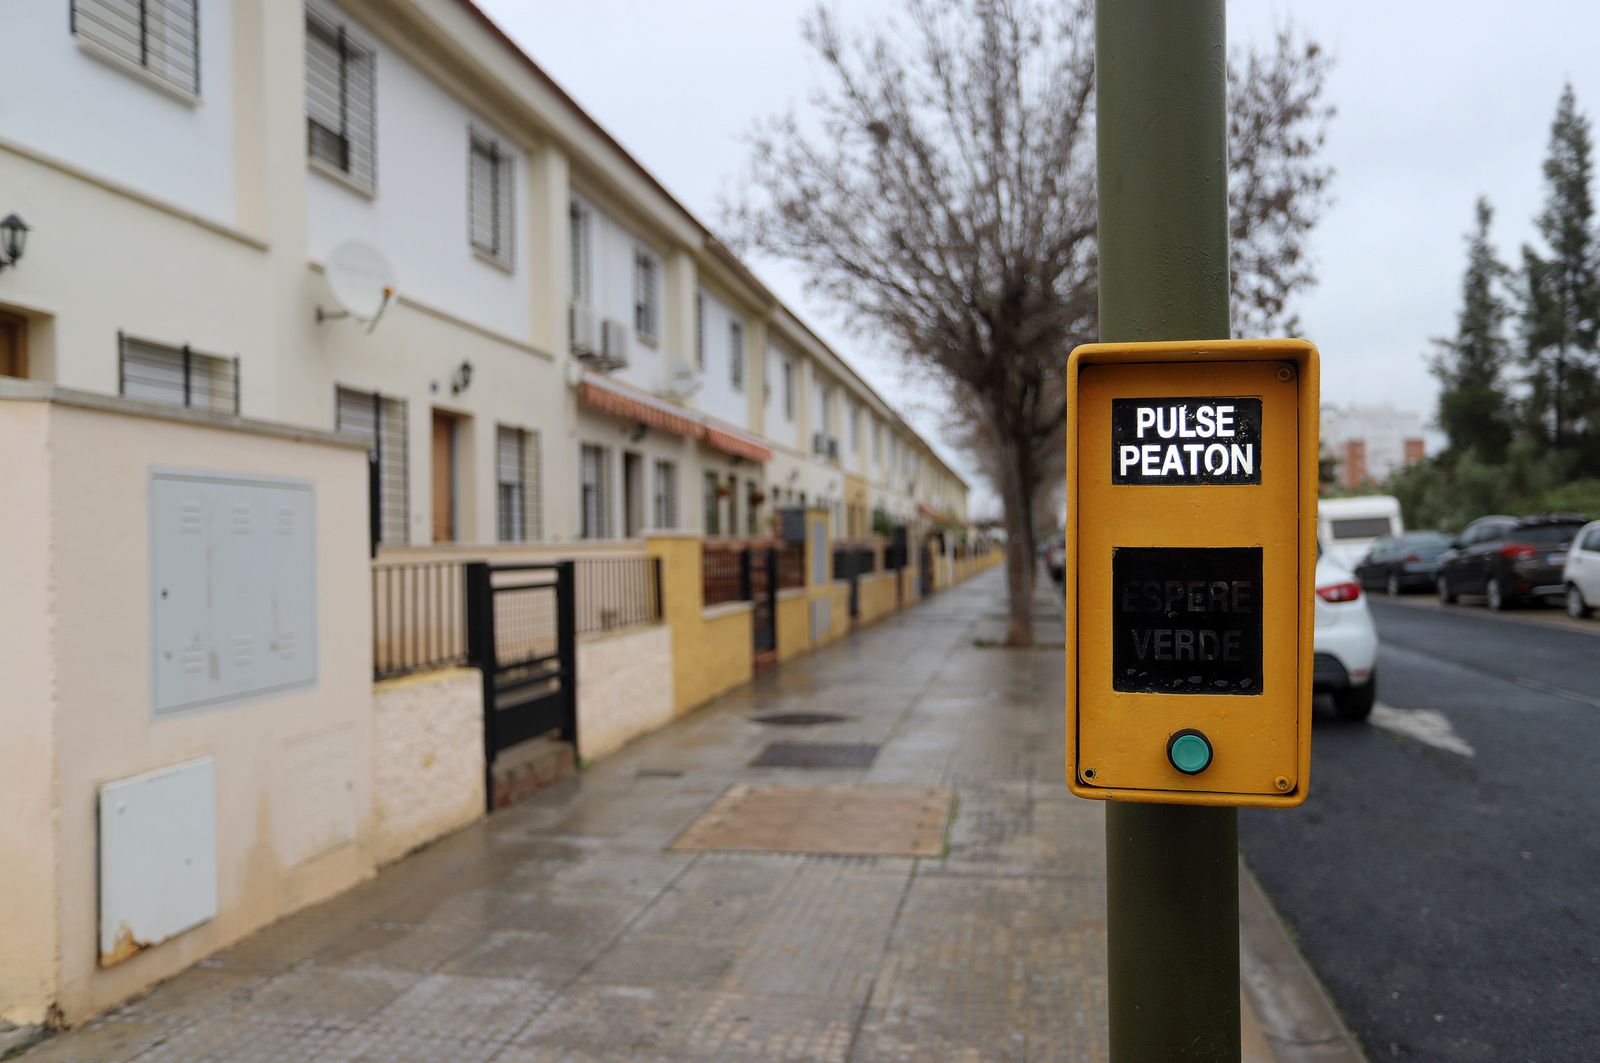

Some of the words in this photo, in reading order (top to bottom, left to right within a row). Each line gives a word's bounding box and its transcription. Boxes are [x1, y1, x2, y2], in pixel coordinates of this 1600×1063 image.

[1137, 405, 1235, 438] PULSE
[1120, 443, 1253, 476] PEATON
[1122, 579, 1251, 612] ESPERE
[1132, 628, 1243, 661] VERDE
